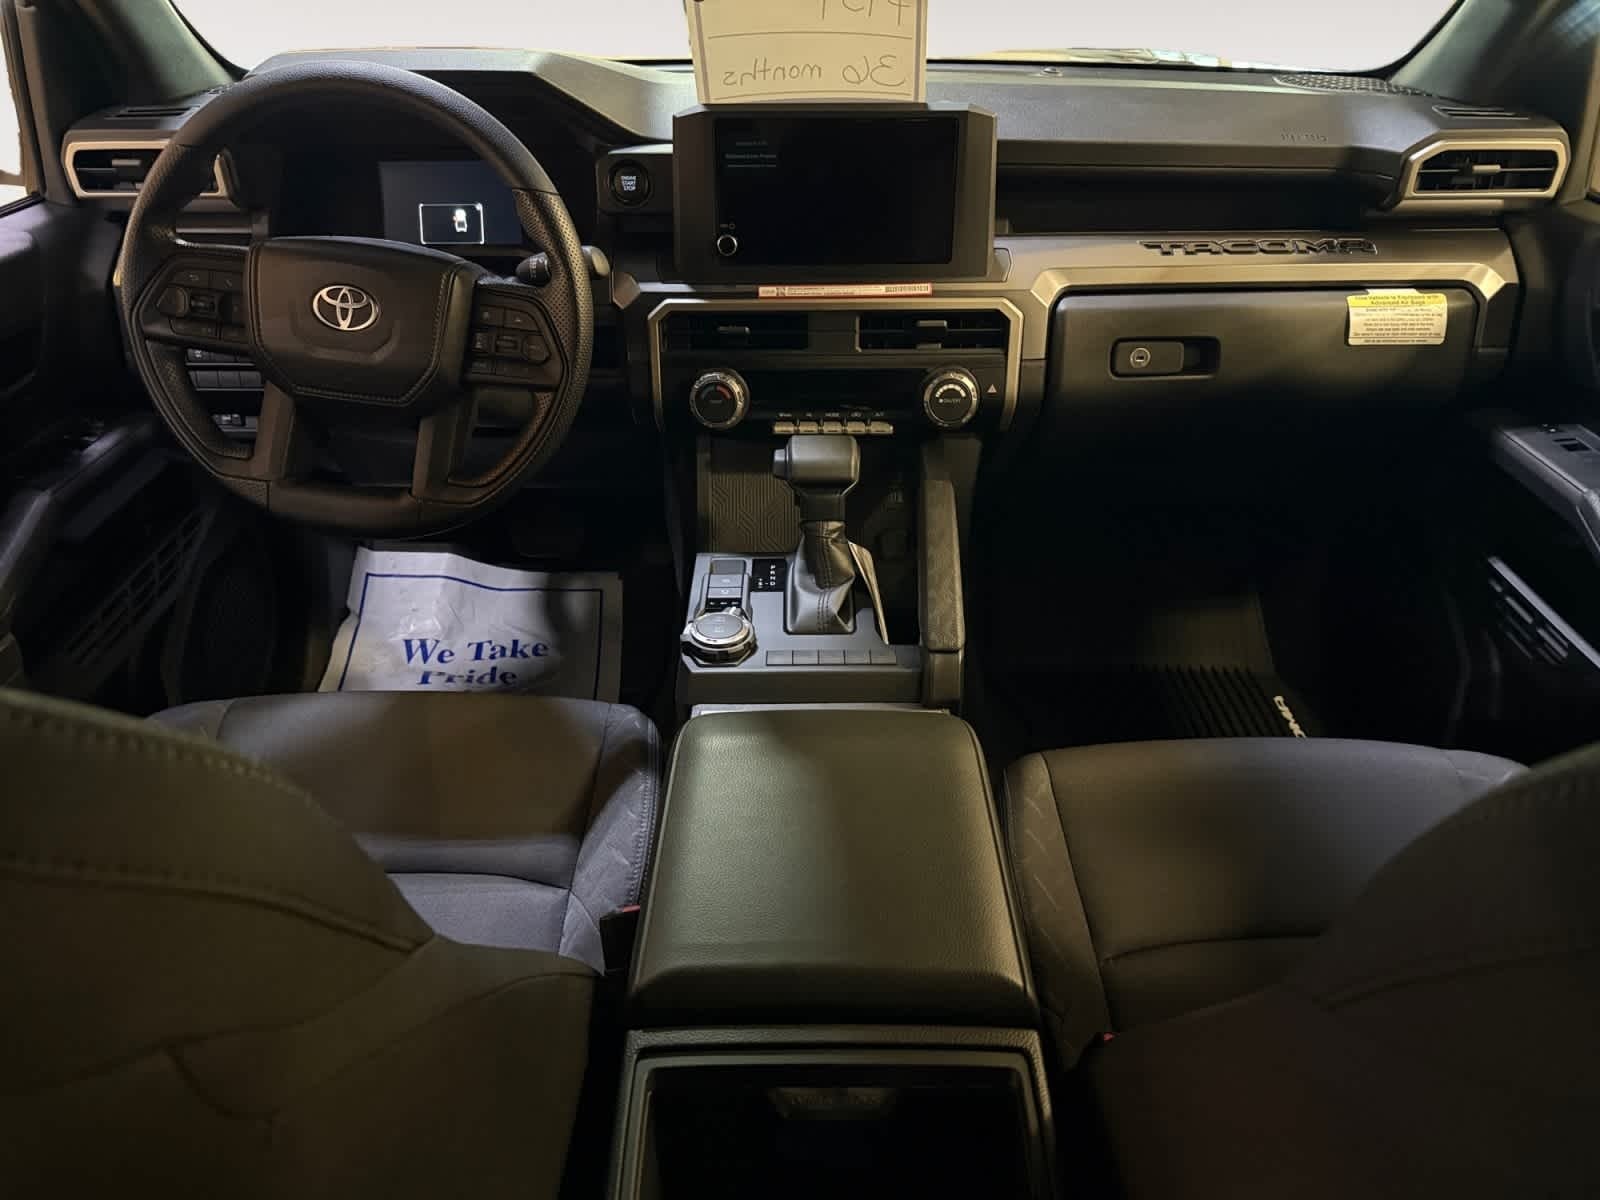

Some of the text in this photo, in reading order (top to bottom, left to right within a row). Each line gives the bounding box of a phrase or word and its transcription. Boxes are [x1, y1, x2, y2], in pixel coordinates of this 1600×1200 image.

[1137, 238, 1378, 256] TACOMA
[403, 638, 550, 665] We Take
